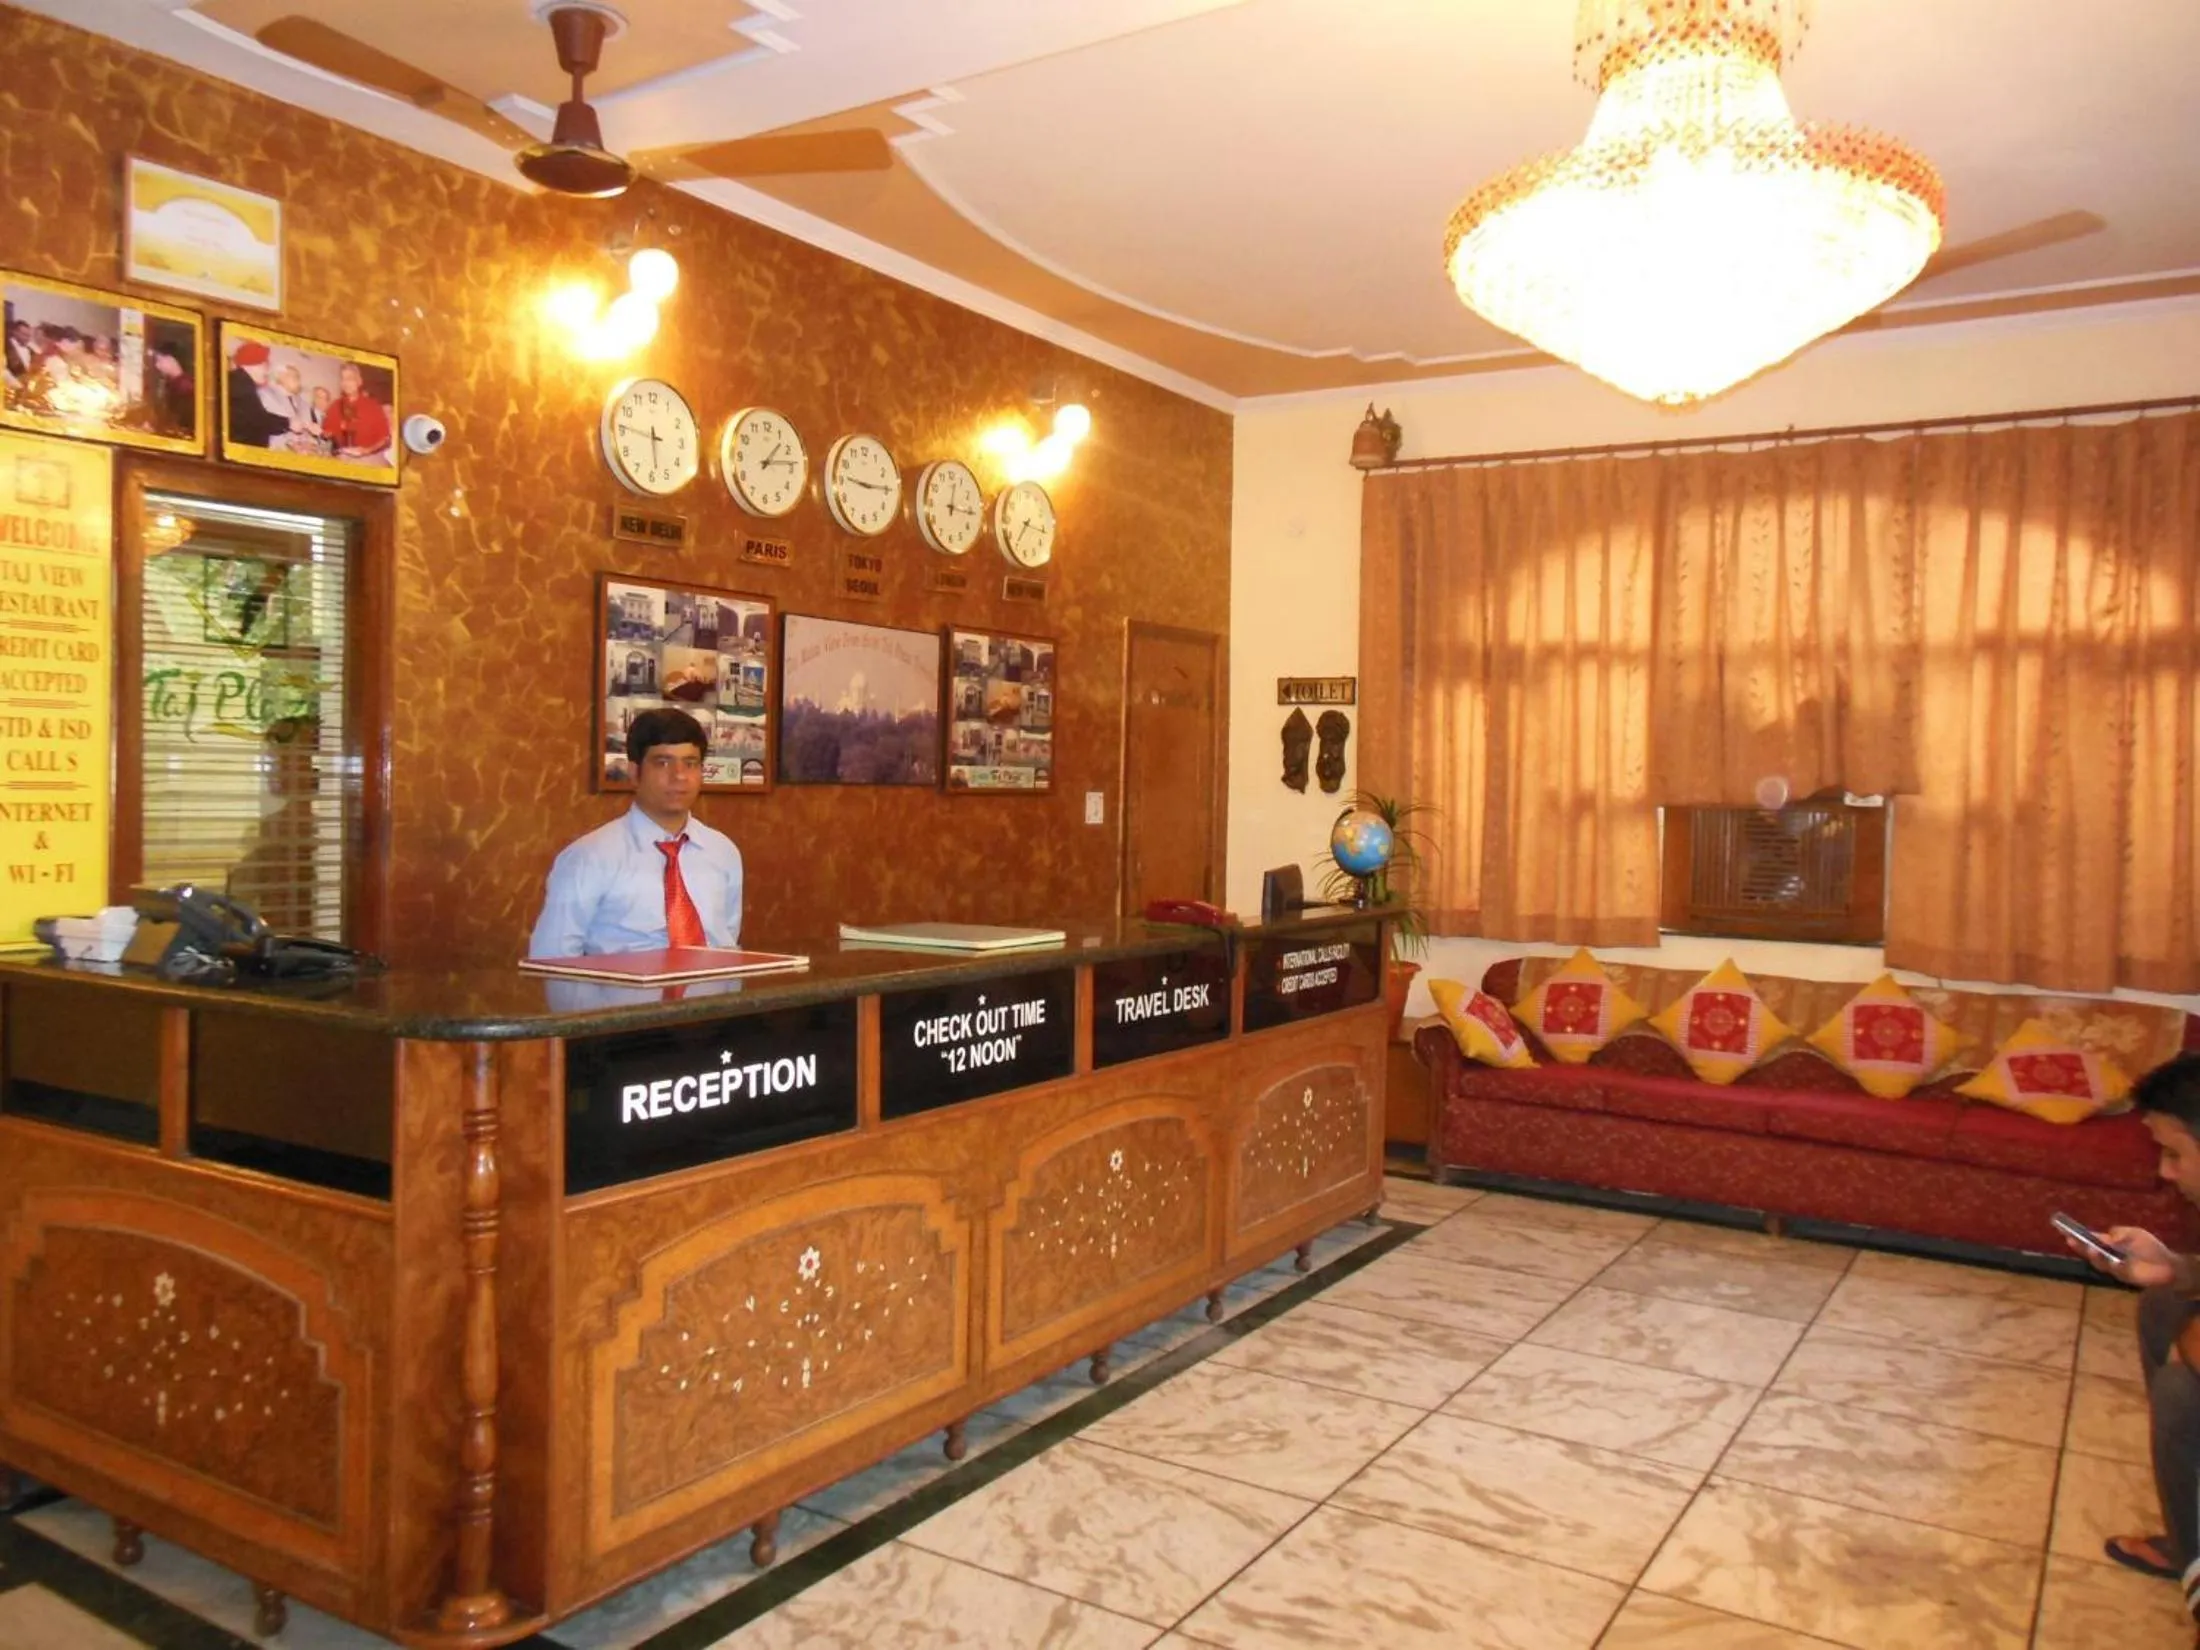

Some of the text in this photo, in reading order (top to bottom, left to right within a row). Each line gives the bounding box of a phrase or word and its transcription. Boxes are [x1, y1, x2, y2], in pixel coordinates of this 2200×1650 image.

[746, 540, 787, 559] PARIS
[848, 553, 882, 571] TOKYO
[39, 563, 85, 588] VIEW
[0, 590, 99, 620] ESTAURANT
[0, 635, 100, 663] REDIT CARD
[1294, 682, 1349, 700] TOILET
[38, 718, 52, 739] &
[60, 719, 92, 740] ISD
[0, 802, 93, 822] NTERNET
[33, 830, 49, 850] &
[1116, 983, 1209, 1023] TRAVEL DESK
[914, 999, 1045, 1047] CHECK OUT TIME
[622, 1054, 816, 1123] RECEPTION
